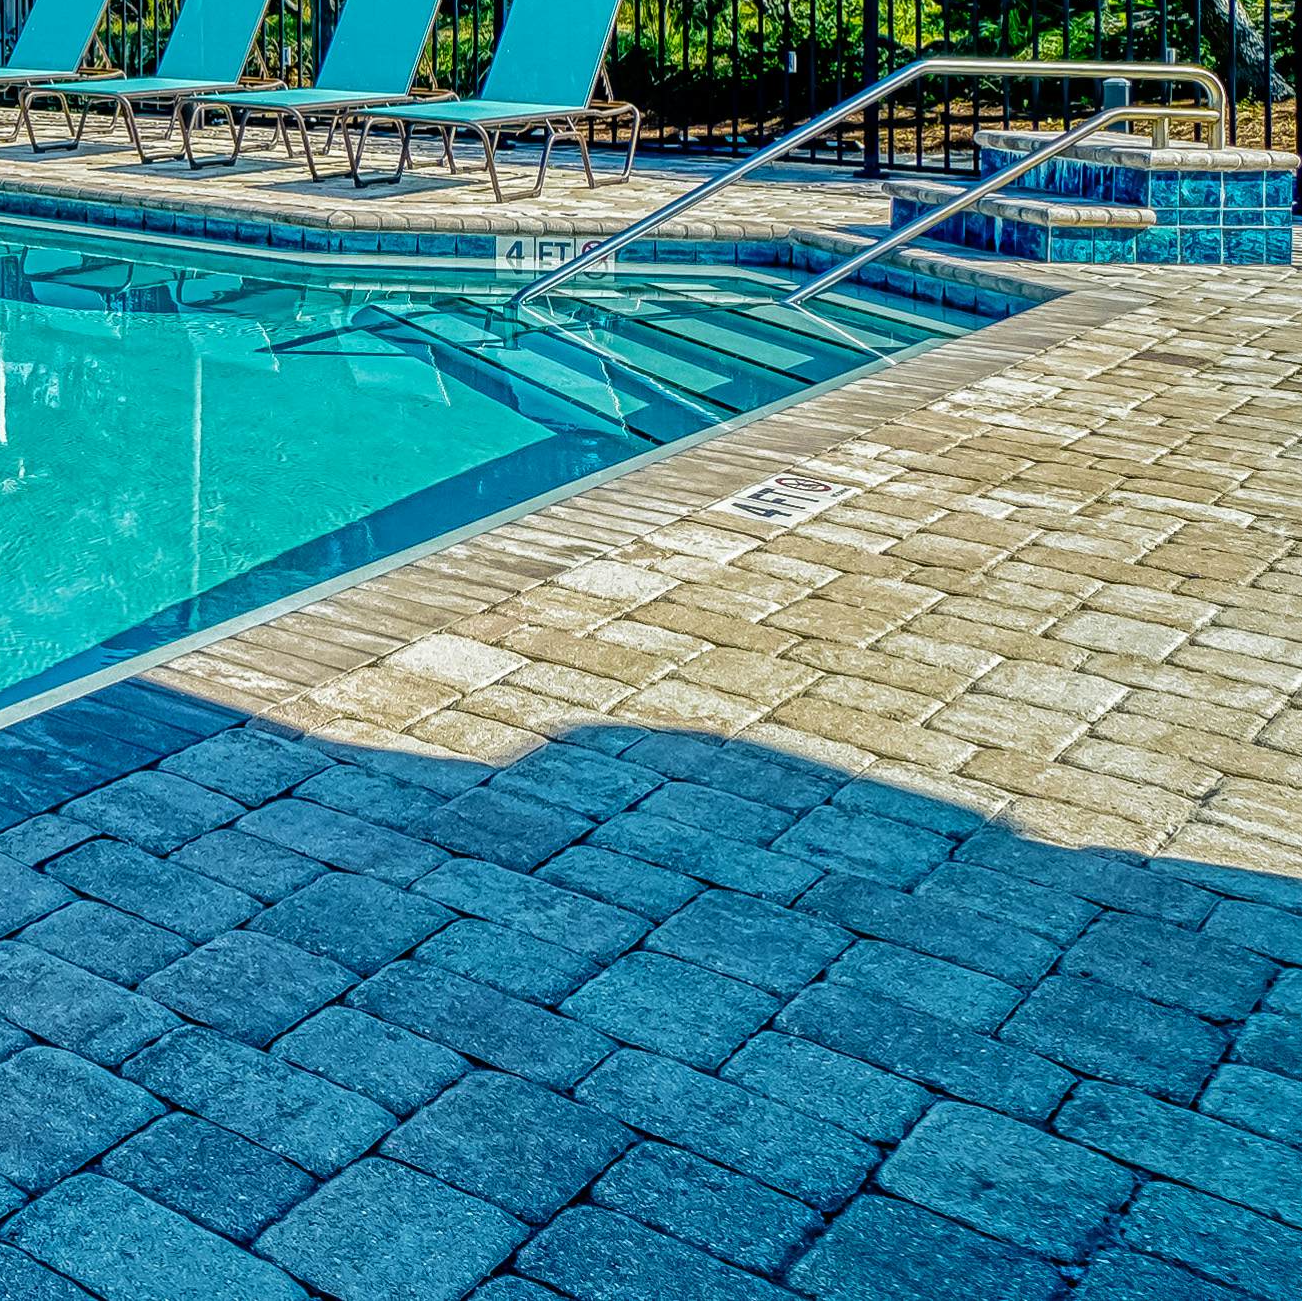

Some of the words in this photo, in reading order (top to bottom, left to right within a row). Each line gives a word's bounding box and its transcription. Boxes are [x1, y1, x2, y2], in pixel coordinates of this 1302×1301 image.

[506, 240, 525, 260] 4
[538, 241, 572, 262] FT
[747, 487, 820, 510] FT
[731, 502, 793, 518] 4
